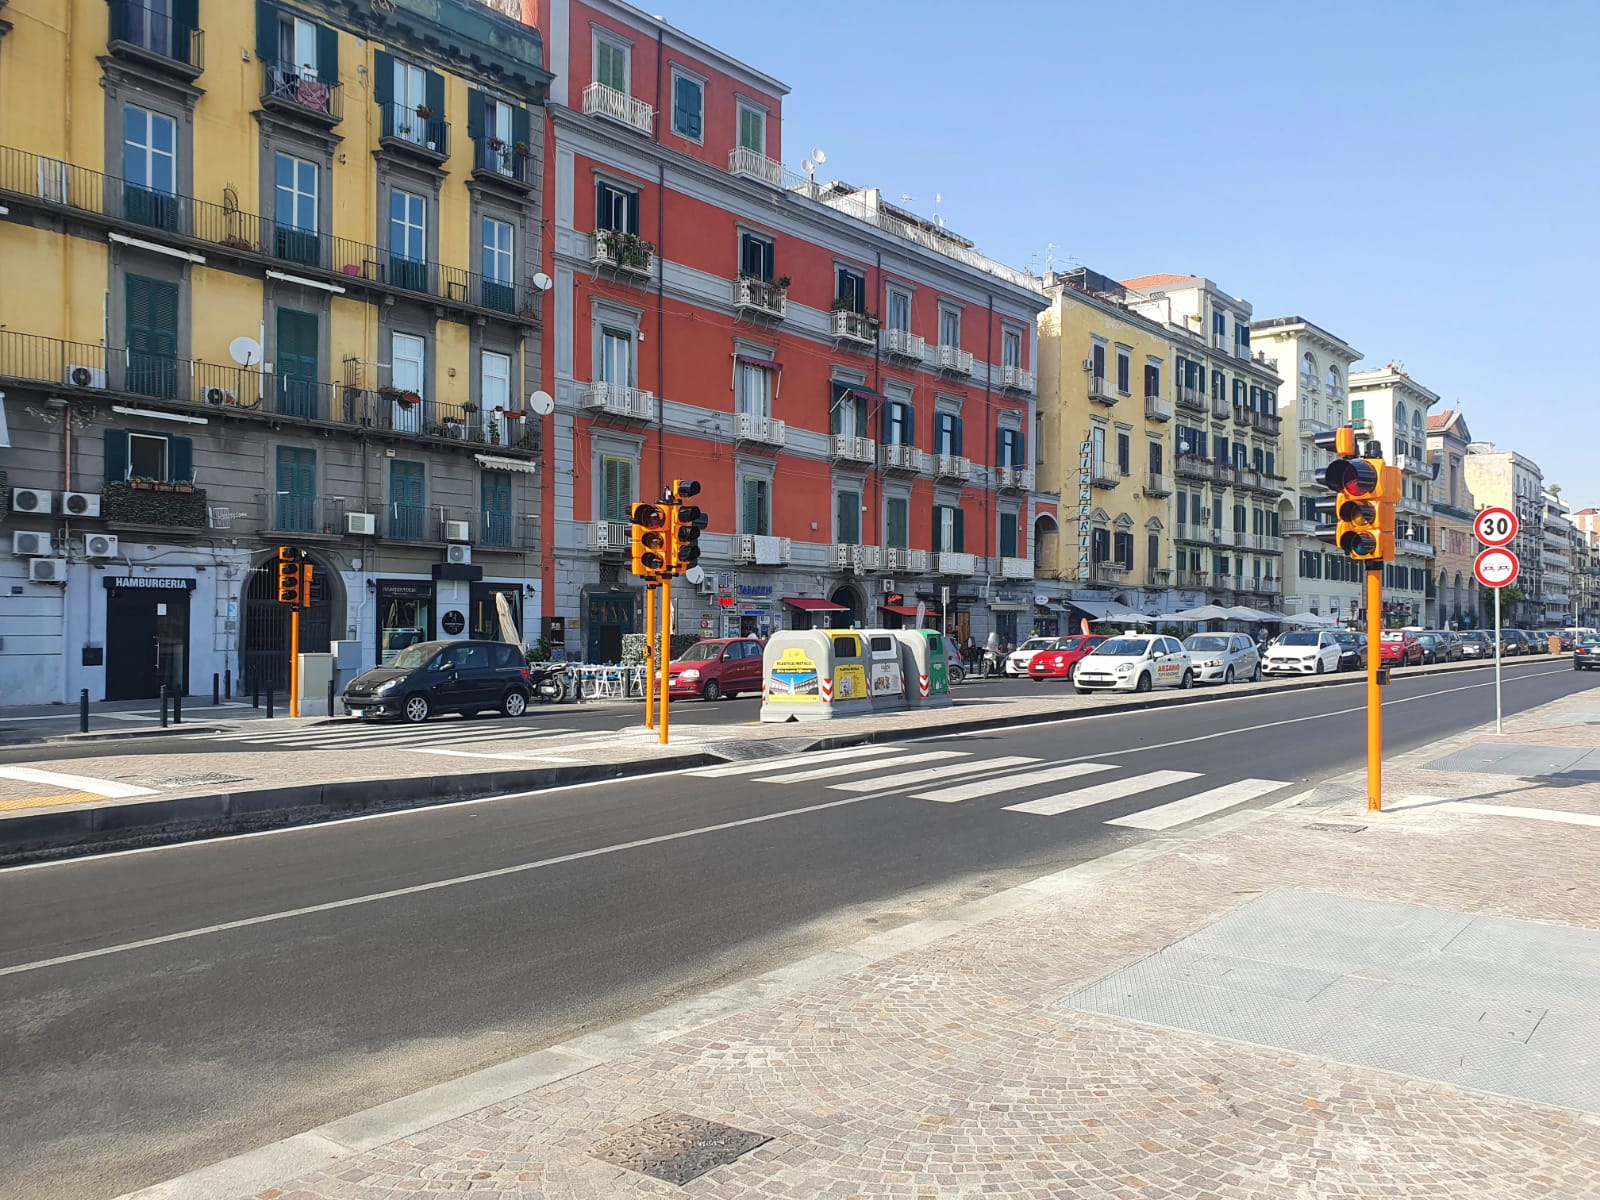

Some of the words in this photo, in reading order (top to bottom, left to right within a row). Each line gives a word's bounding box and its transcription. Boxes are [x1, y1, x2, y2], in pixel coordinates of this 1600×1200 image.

[1080, 442, 1090, 562] PIZZERIA
[1484, 518, 1508, 535] 30
[115, 577, 187, 589] HAMBURGERIA
